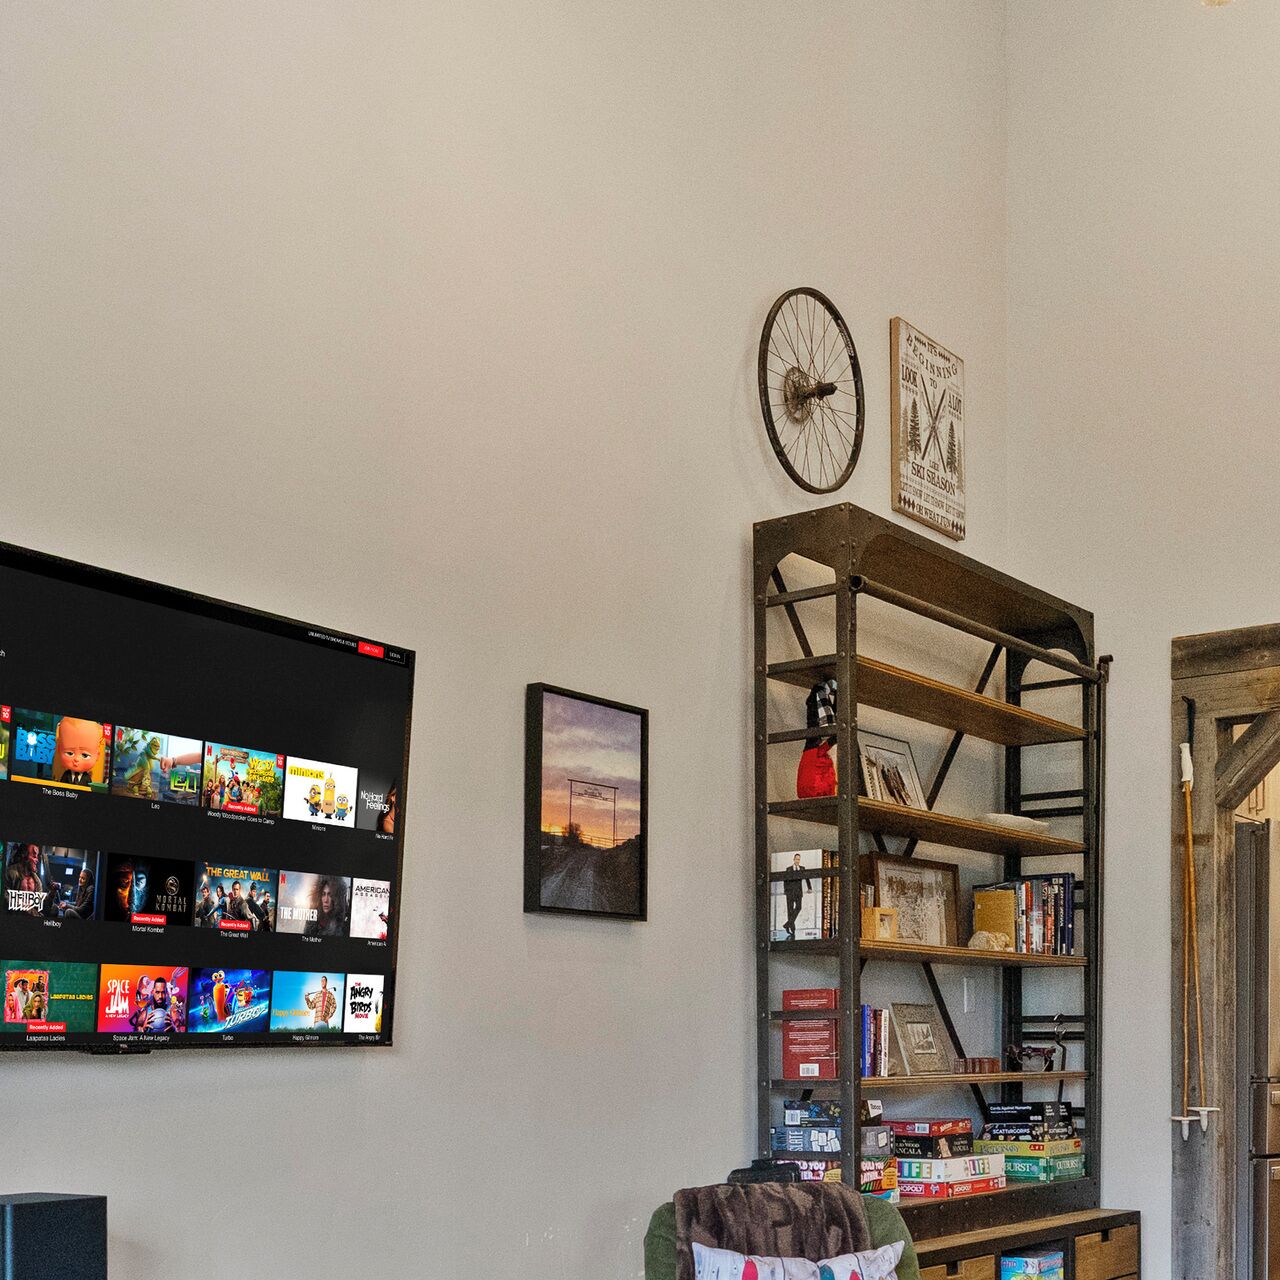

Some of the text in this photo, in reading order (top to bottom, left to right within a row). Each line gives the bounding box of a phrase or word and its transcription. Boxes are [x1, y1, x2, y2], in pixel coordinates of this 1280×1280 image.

[906, 333, 958, 379] BEGINNING
[901, 364, 918, 388] LOOK
[911, 461, 956, 496] SKI SEASON
[288, 765, 325, 780] minions
[42, 787, 79, 800] The Boss Baby
[368, 792, 384, 803] Hard
[207, 810, 221, 818] Woody
[227, 803, 257, 813] Recently Added
[365, 800, 391, 814] Feelings
[206, 866, 270, 882] THE GREAT WALL
[355, 885, 390, 895] AMERICAN
[156, 894, 187, 904] MORTAL
[155, 903, 187, 913] KOMBAT
[280, 906, 318, 922] THE MOTHER
[43, 919, 62, 928] Hellboy
[133, 915, 165, 924] Recently Added
[146, 926, 165, 934] Kombat
[107, 979, 130, 995] SPACE
[349, 985, 374, 1000] ANGRY
[105, 992, 130, 1014] JAM
[349, 1000, 372, 1015] BIRDS
[224, 1005, 268, 1030] TURBO
[788, 1130, 803, 1152] SLATE
[895, 1147, 922, 1155] ANCALA
[969, 1158, 991, 1176] LIFE
[1005, 1162, 1032, 1172] BURST
